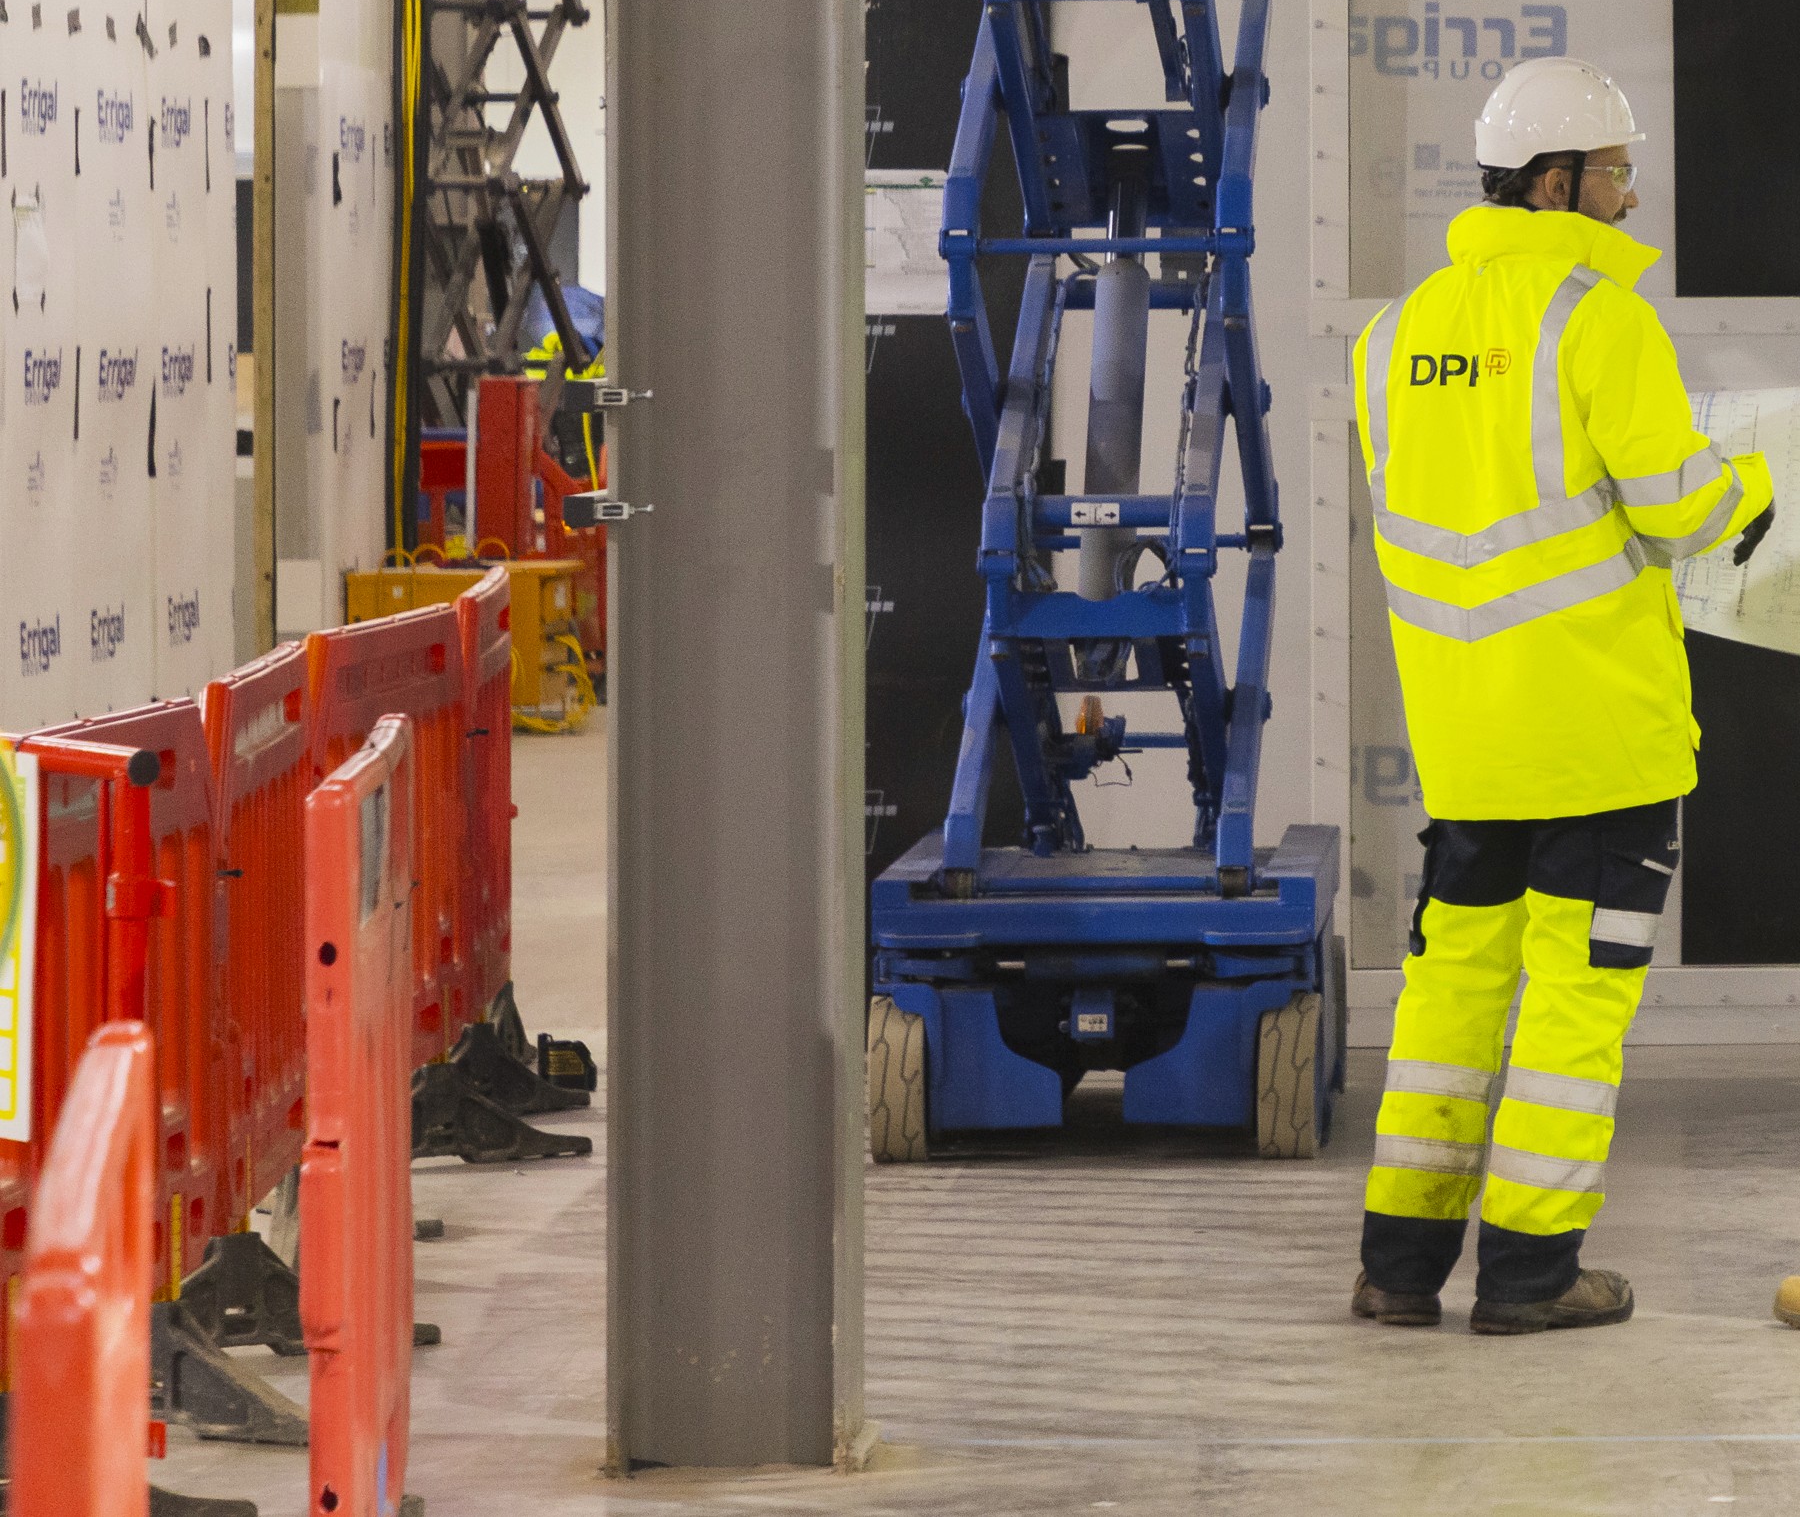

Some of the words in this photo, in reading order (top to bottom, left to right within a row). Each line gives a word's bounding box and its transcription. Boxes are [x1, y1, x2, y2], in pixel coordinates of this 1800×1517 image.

[21, 77, 57, 133] Errigal
[97, 88, 133, 143] Errigal
[161, 96, 191, 148] Errigal
[25, 346, 62, 403] Errigal
[99, 346, 138, 399] Errigal
[20, 610, 60, 671] Errigal
[91, 601, 125, 658] Errigal
